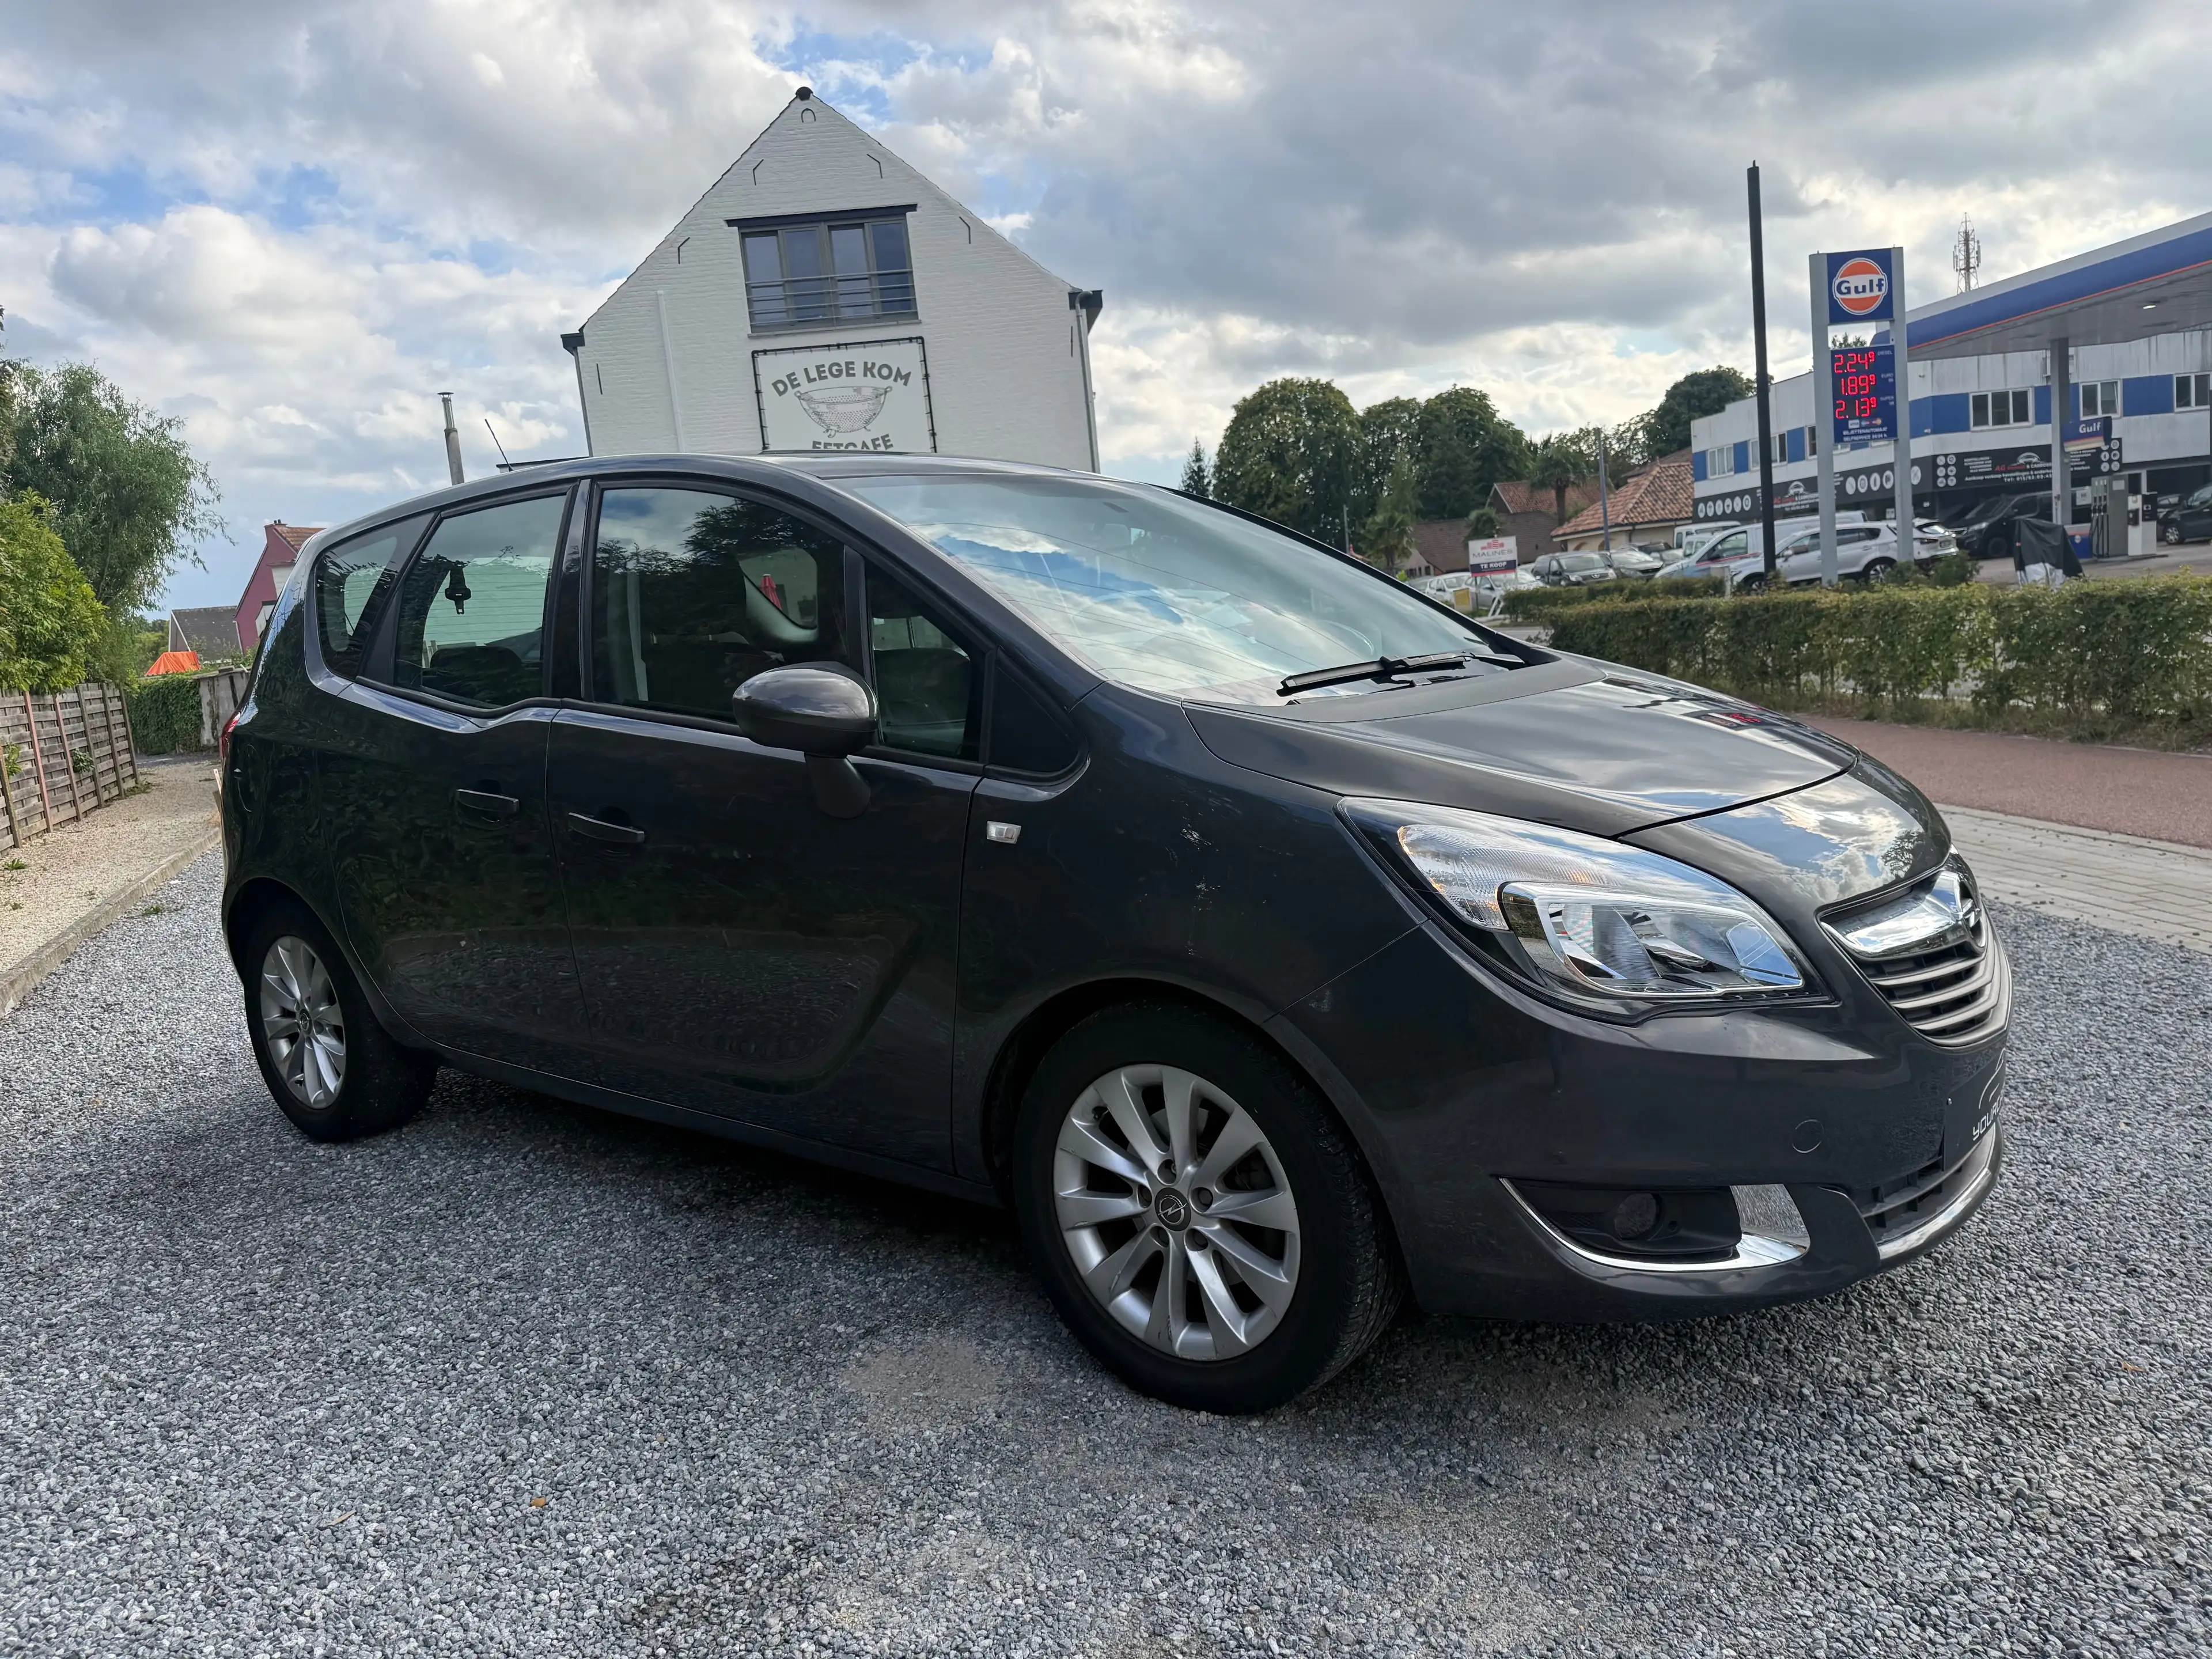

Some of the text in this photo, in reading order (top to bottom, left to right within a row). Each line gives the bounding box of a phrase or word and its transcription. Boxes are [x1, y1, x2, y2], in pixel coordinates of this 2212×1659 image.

[1836, 278, 1884, 296] Gulf
[772, 361, 911, 397] DE LEGE KOM
[2079, 422, 2101, 433] Gulf
[1472, 548, 1513, 558] MALINES
